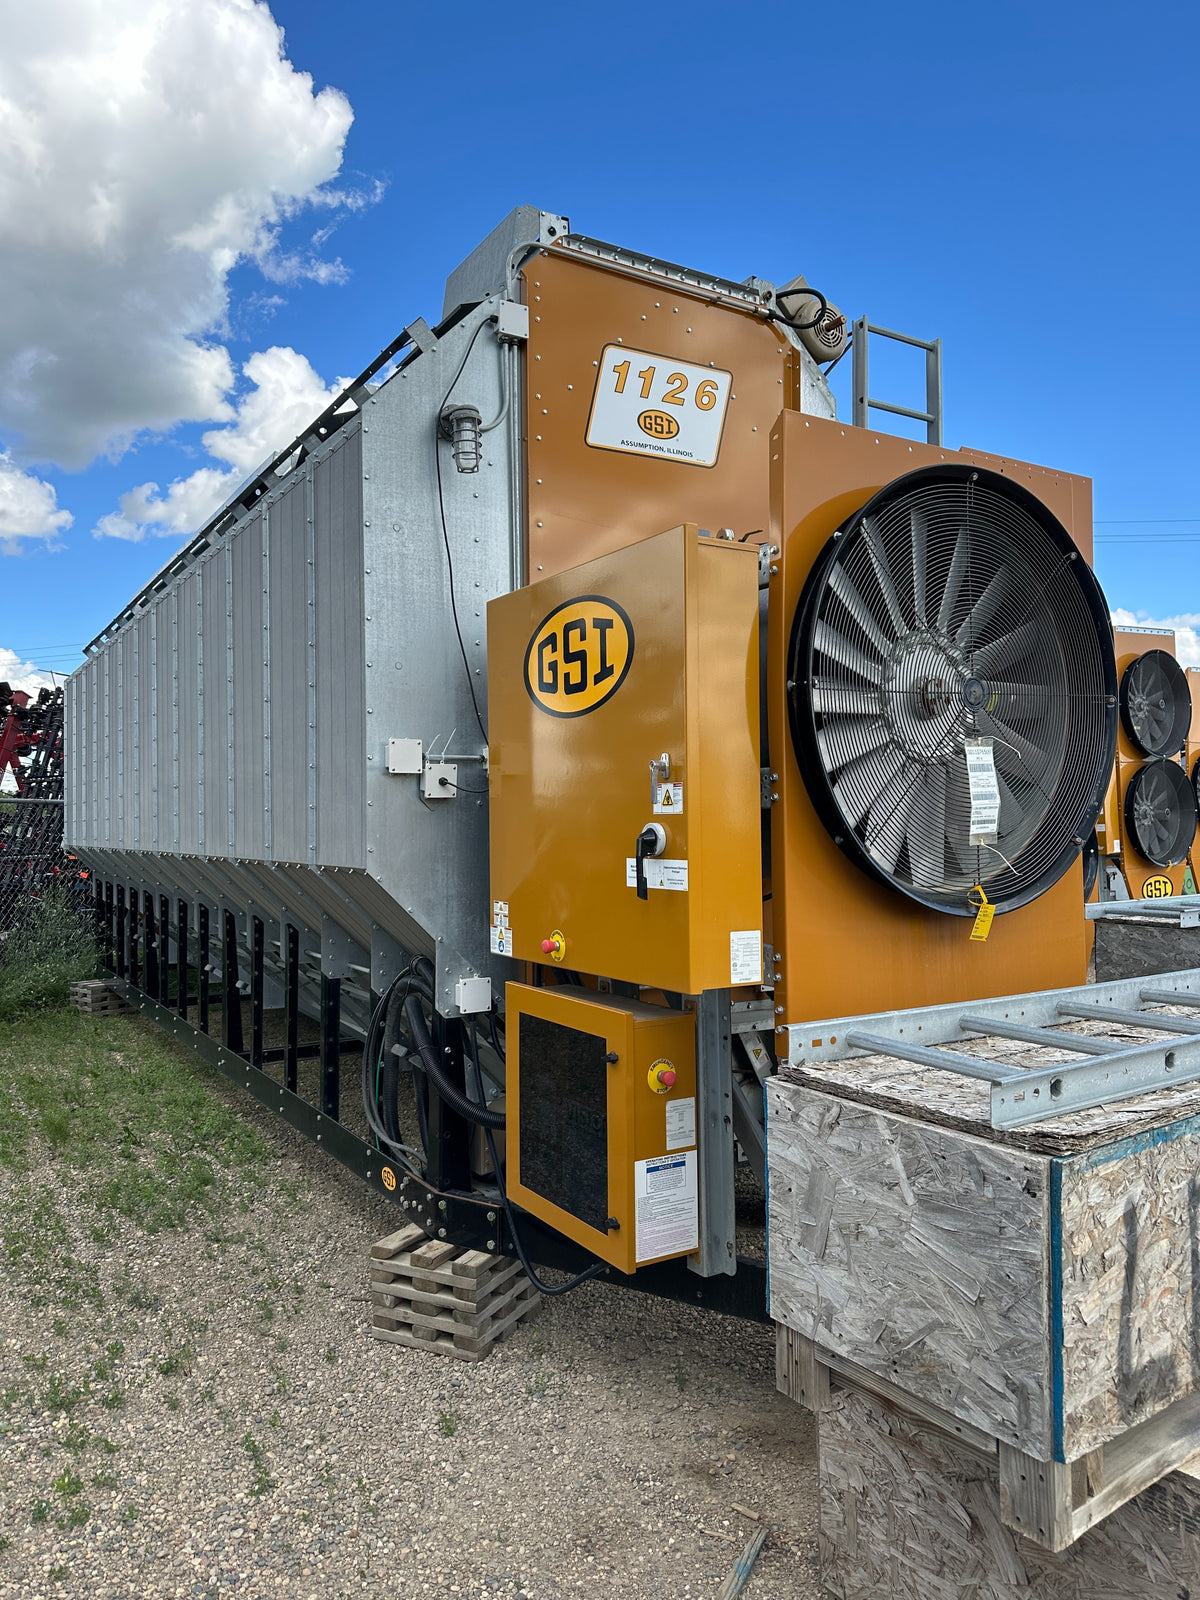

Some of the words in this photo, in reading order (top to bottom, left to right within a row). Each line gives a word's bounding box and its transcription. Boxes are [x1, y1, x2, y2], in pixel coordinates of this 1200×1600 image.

[612, 360, 719, 411] 1126
[643, 414, 674, 434] GSI
[620, 439, 666, 453] ASSUMPTION,
[666, 447, 694, 458] ILLINOIS
[537, 617, 615, 696] GSI
[1146, 880, 1168, 898] GSI
[383, 1170, 394, 1188] GSI
